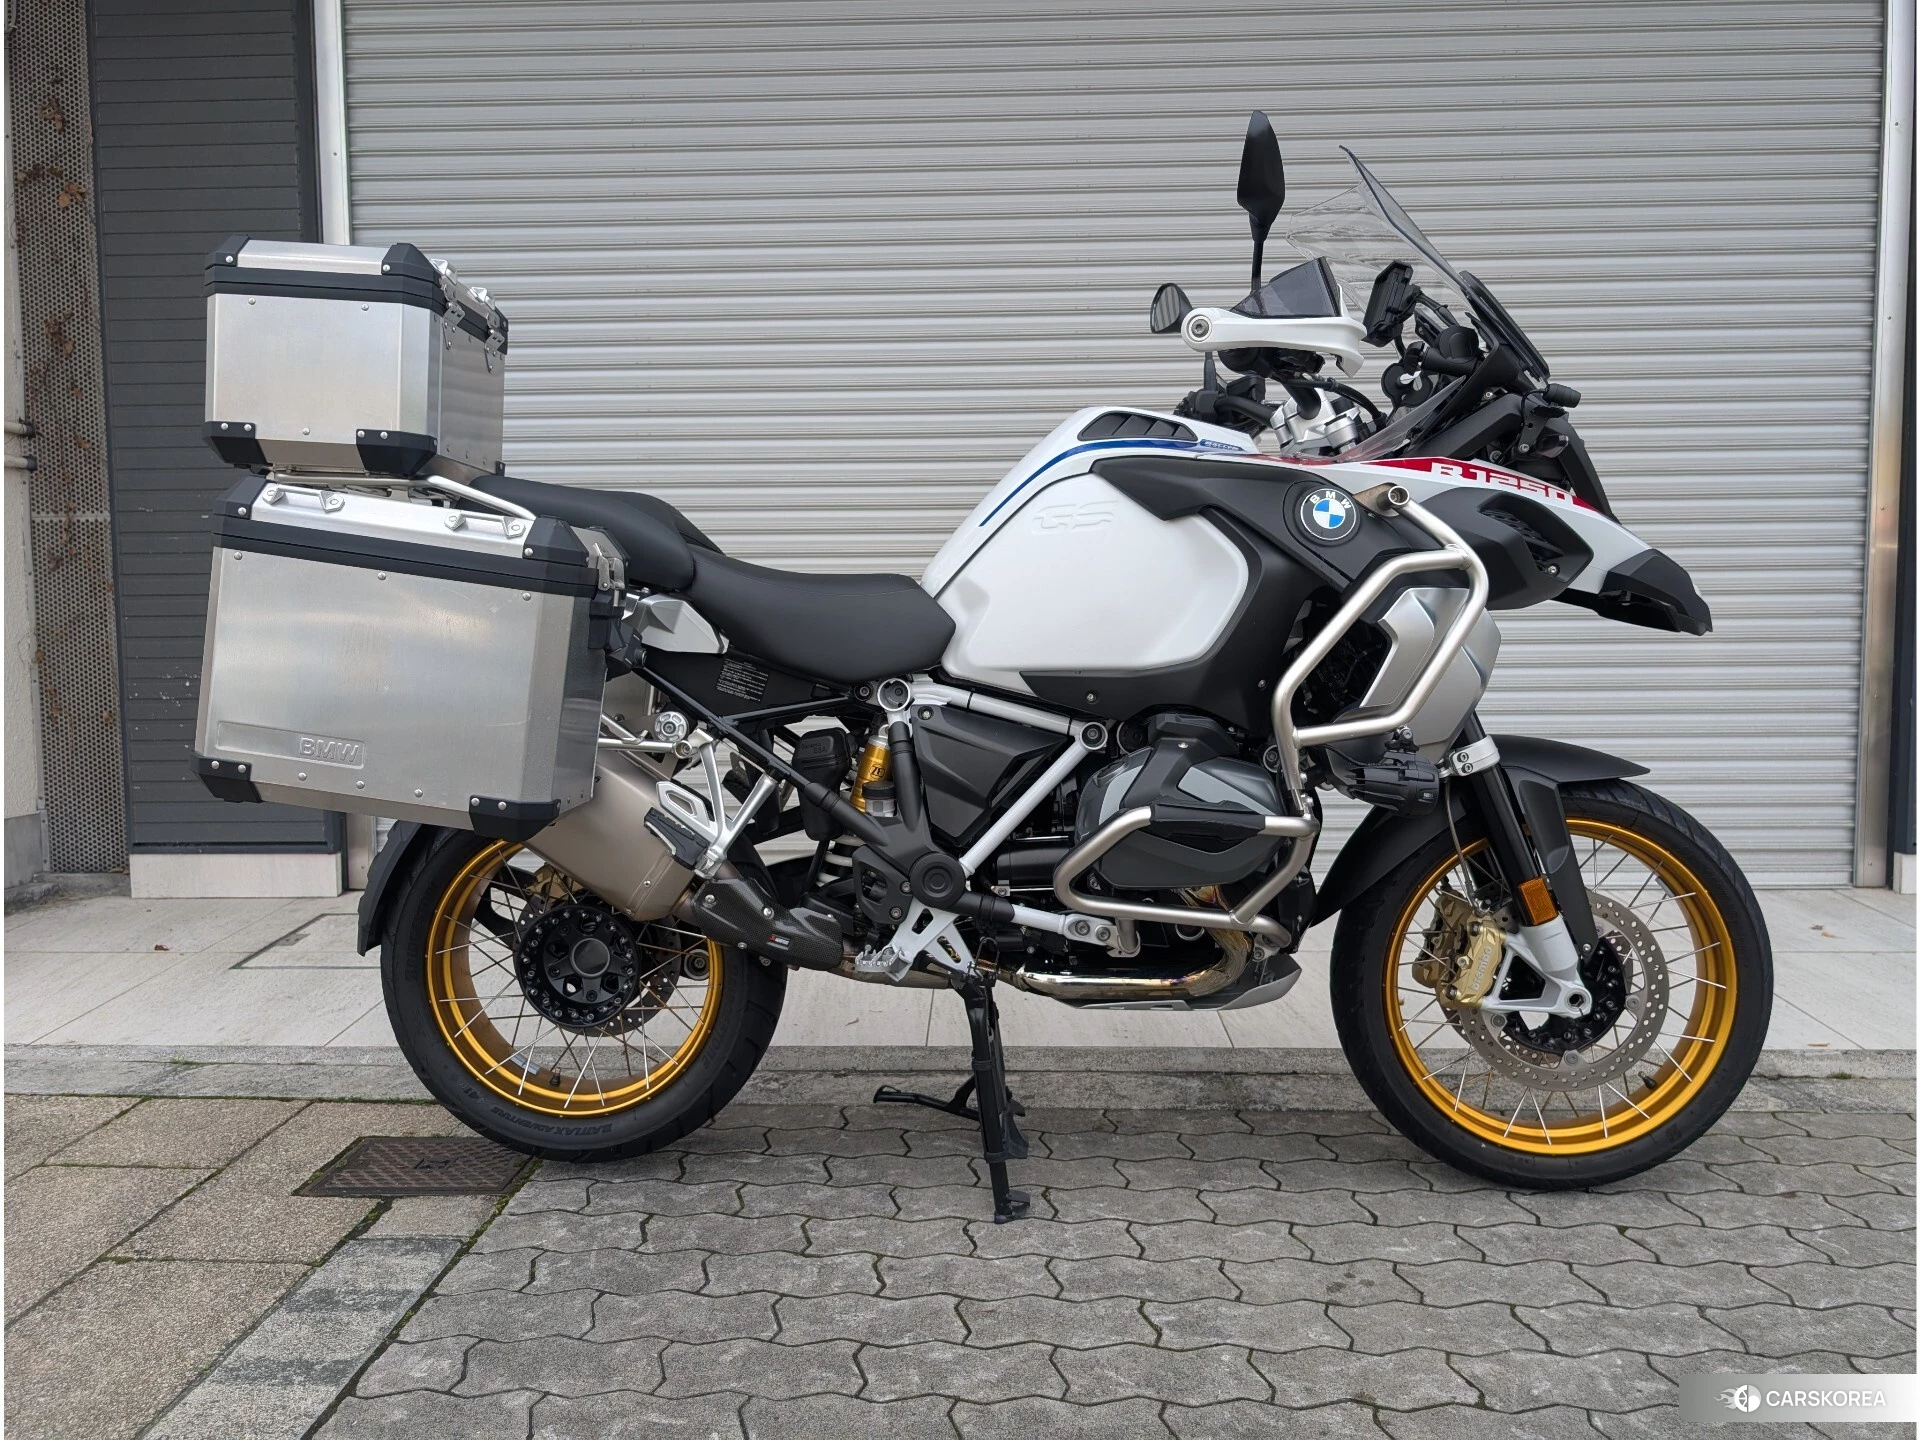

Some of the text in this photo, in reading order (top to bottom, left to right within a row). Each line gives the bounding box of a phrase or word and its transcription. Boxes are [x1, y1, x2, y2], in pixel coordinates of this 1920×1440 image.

[1309, 490, 1352, 510] BMW
[299, 736, 359, 763] BMW
[1470, 944, 1492, 991] brembo
